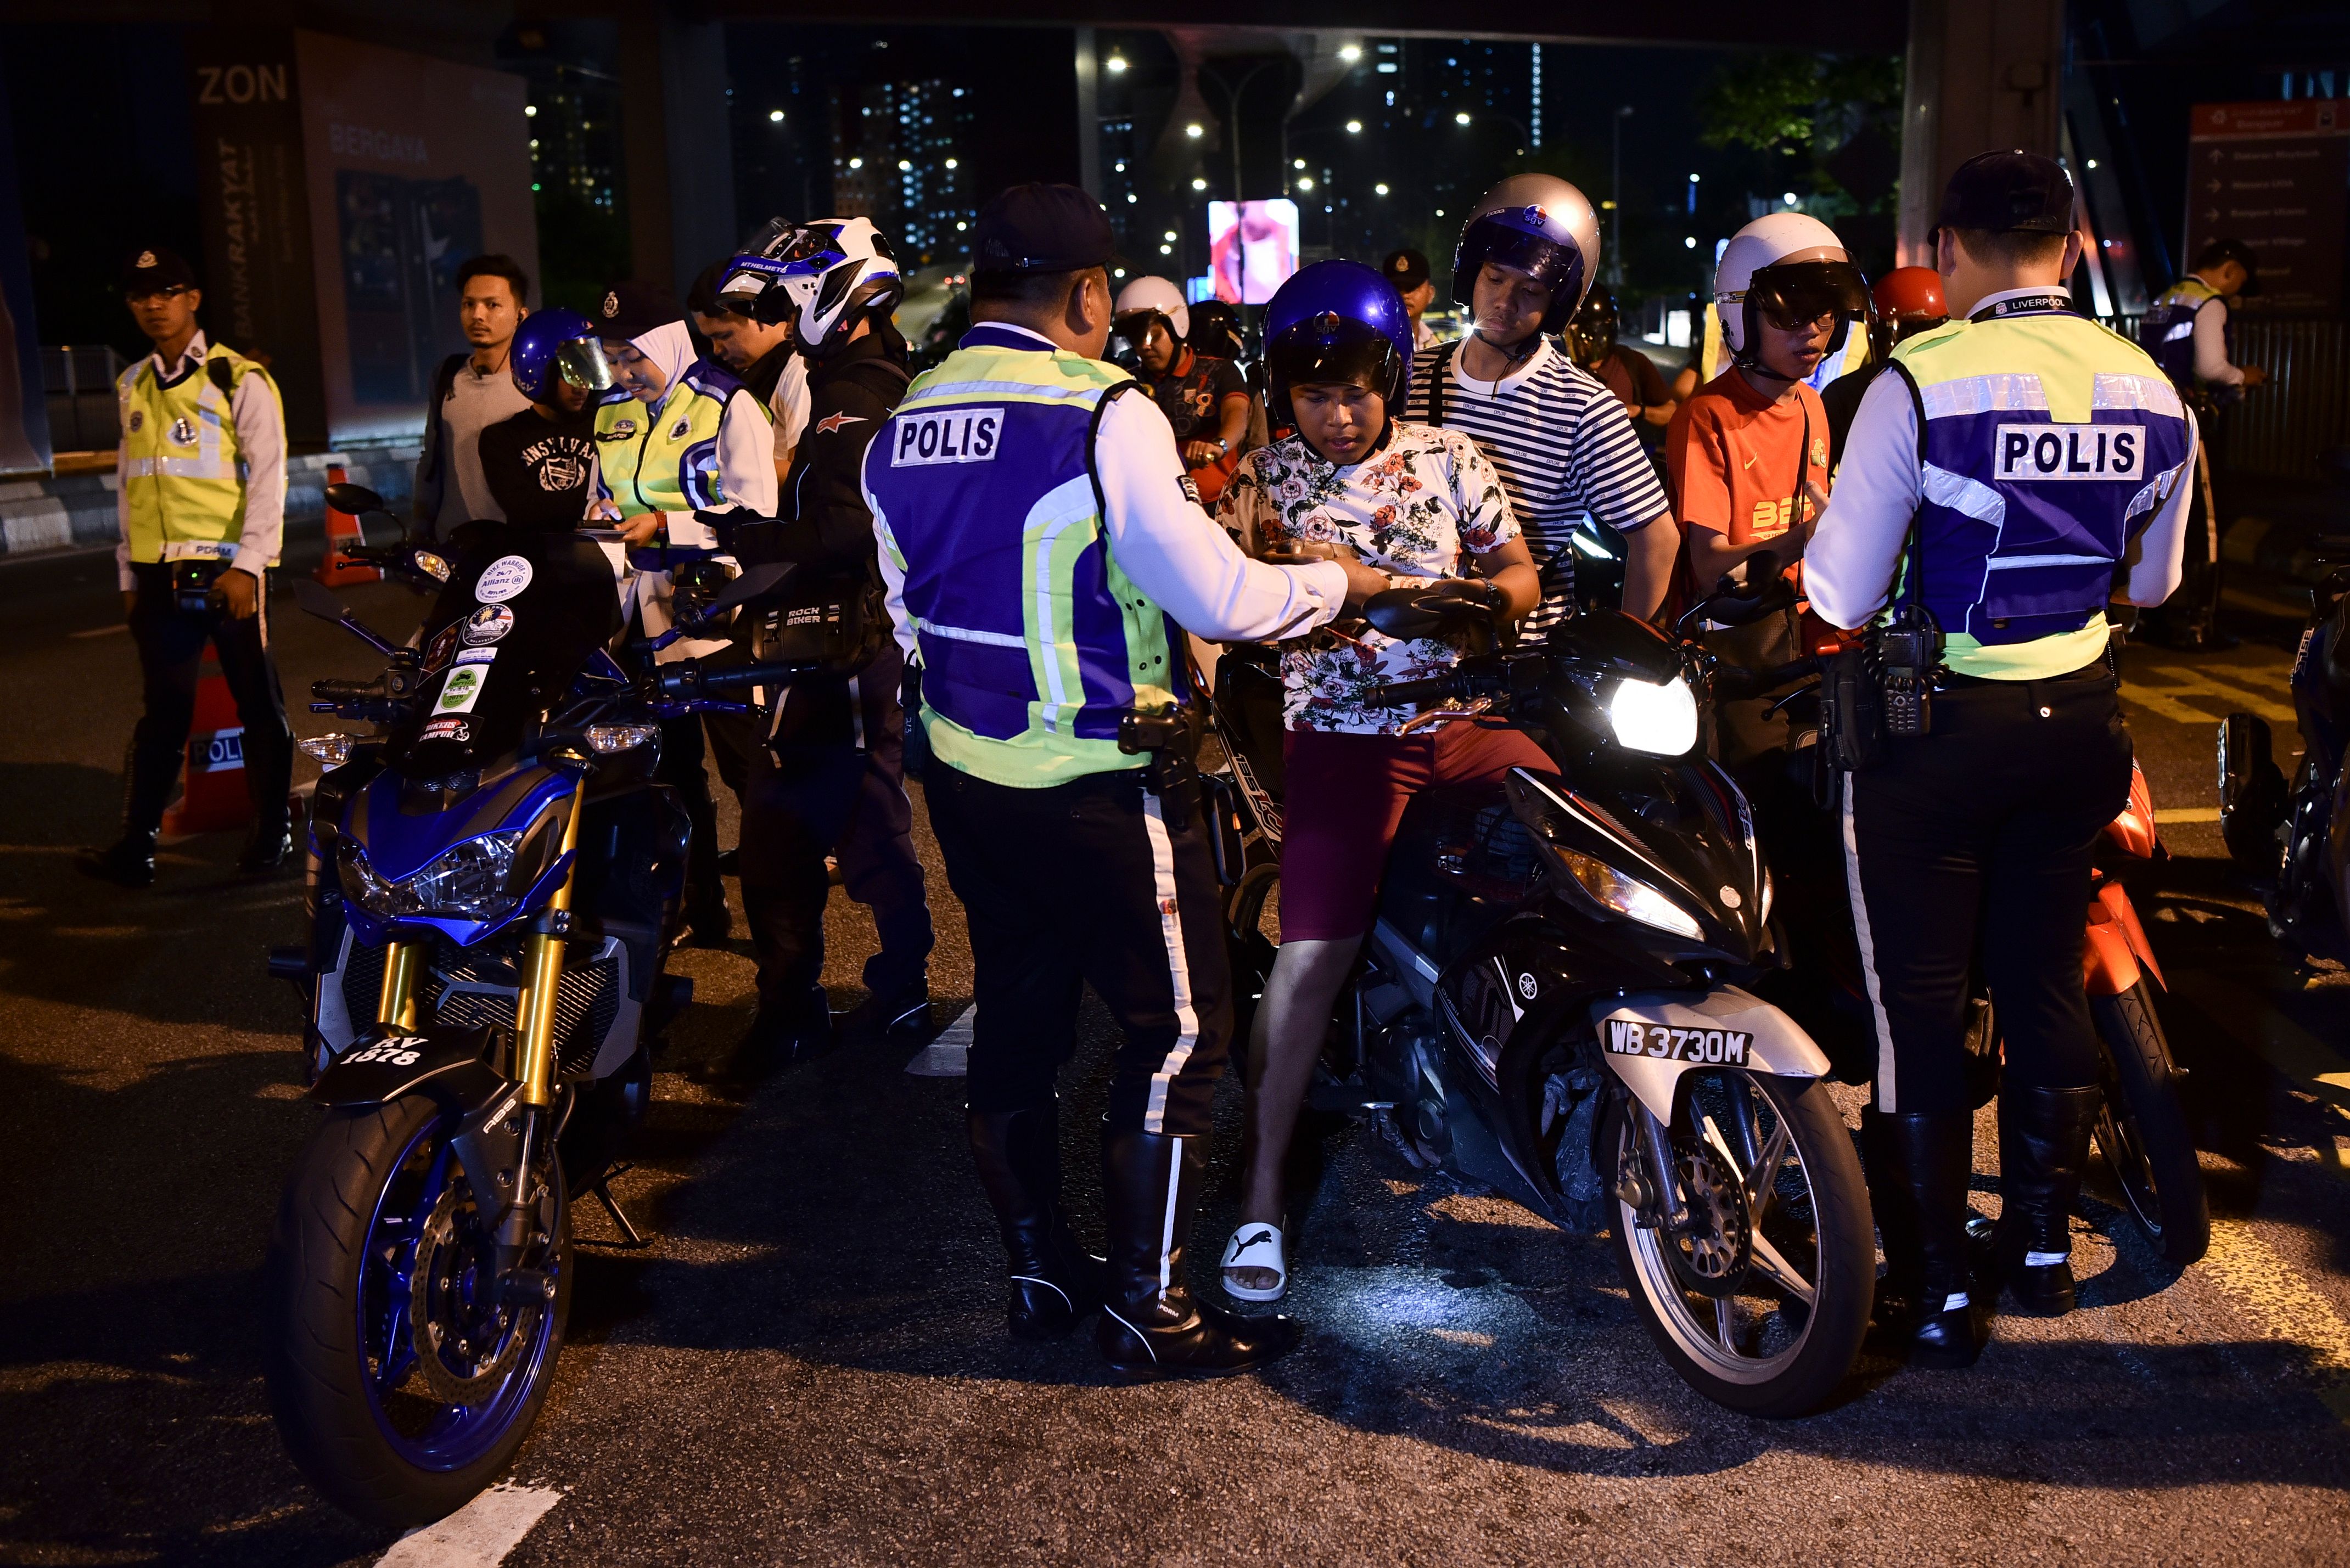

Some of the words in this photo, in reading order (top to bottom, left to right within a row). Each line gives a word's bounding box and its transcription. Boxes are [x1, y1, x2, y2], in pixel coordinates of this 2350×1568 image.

[196, 64, 288, 105] ZON
[1524, 215, 1544, 225] sgv
[2012, 298, 2065, 309] LIVERPOOL
[899, 417, 996, 460] POLIS
[2004, 432, 2135, 473] POLIS
[486, 564, 500, 576] BIKE
[502, 560, 525, 572] WARRIOR
[481, 578, 510, 588] Allianz
[787, 615, 821, 626] BIKER
[788, 607, 820, 618] ROCK
[425, 721, 457, 732] BIKERS
[192, 736, 244, 765] POLI
[369, 1037, 429, 1049] RV
[1611, 1021, 1645, 1054] WB
[1647, 1027, 1746, 1064] 3730M
[339, 1048, 421, 1066] 1878
[483, 1098, 517, 1134] ABS
